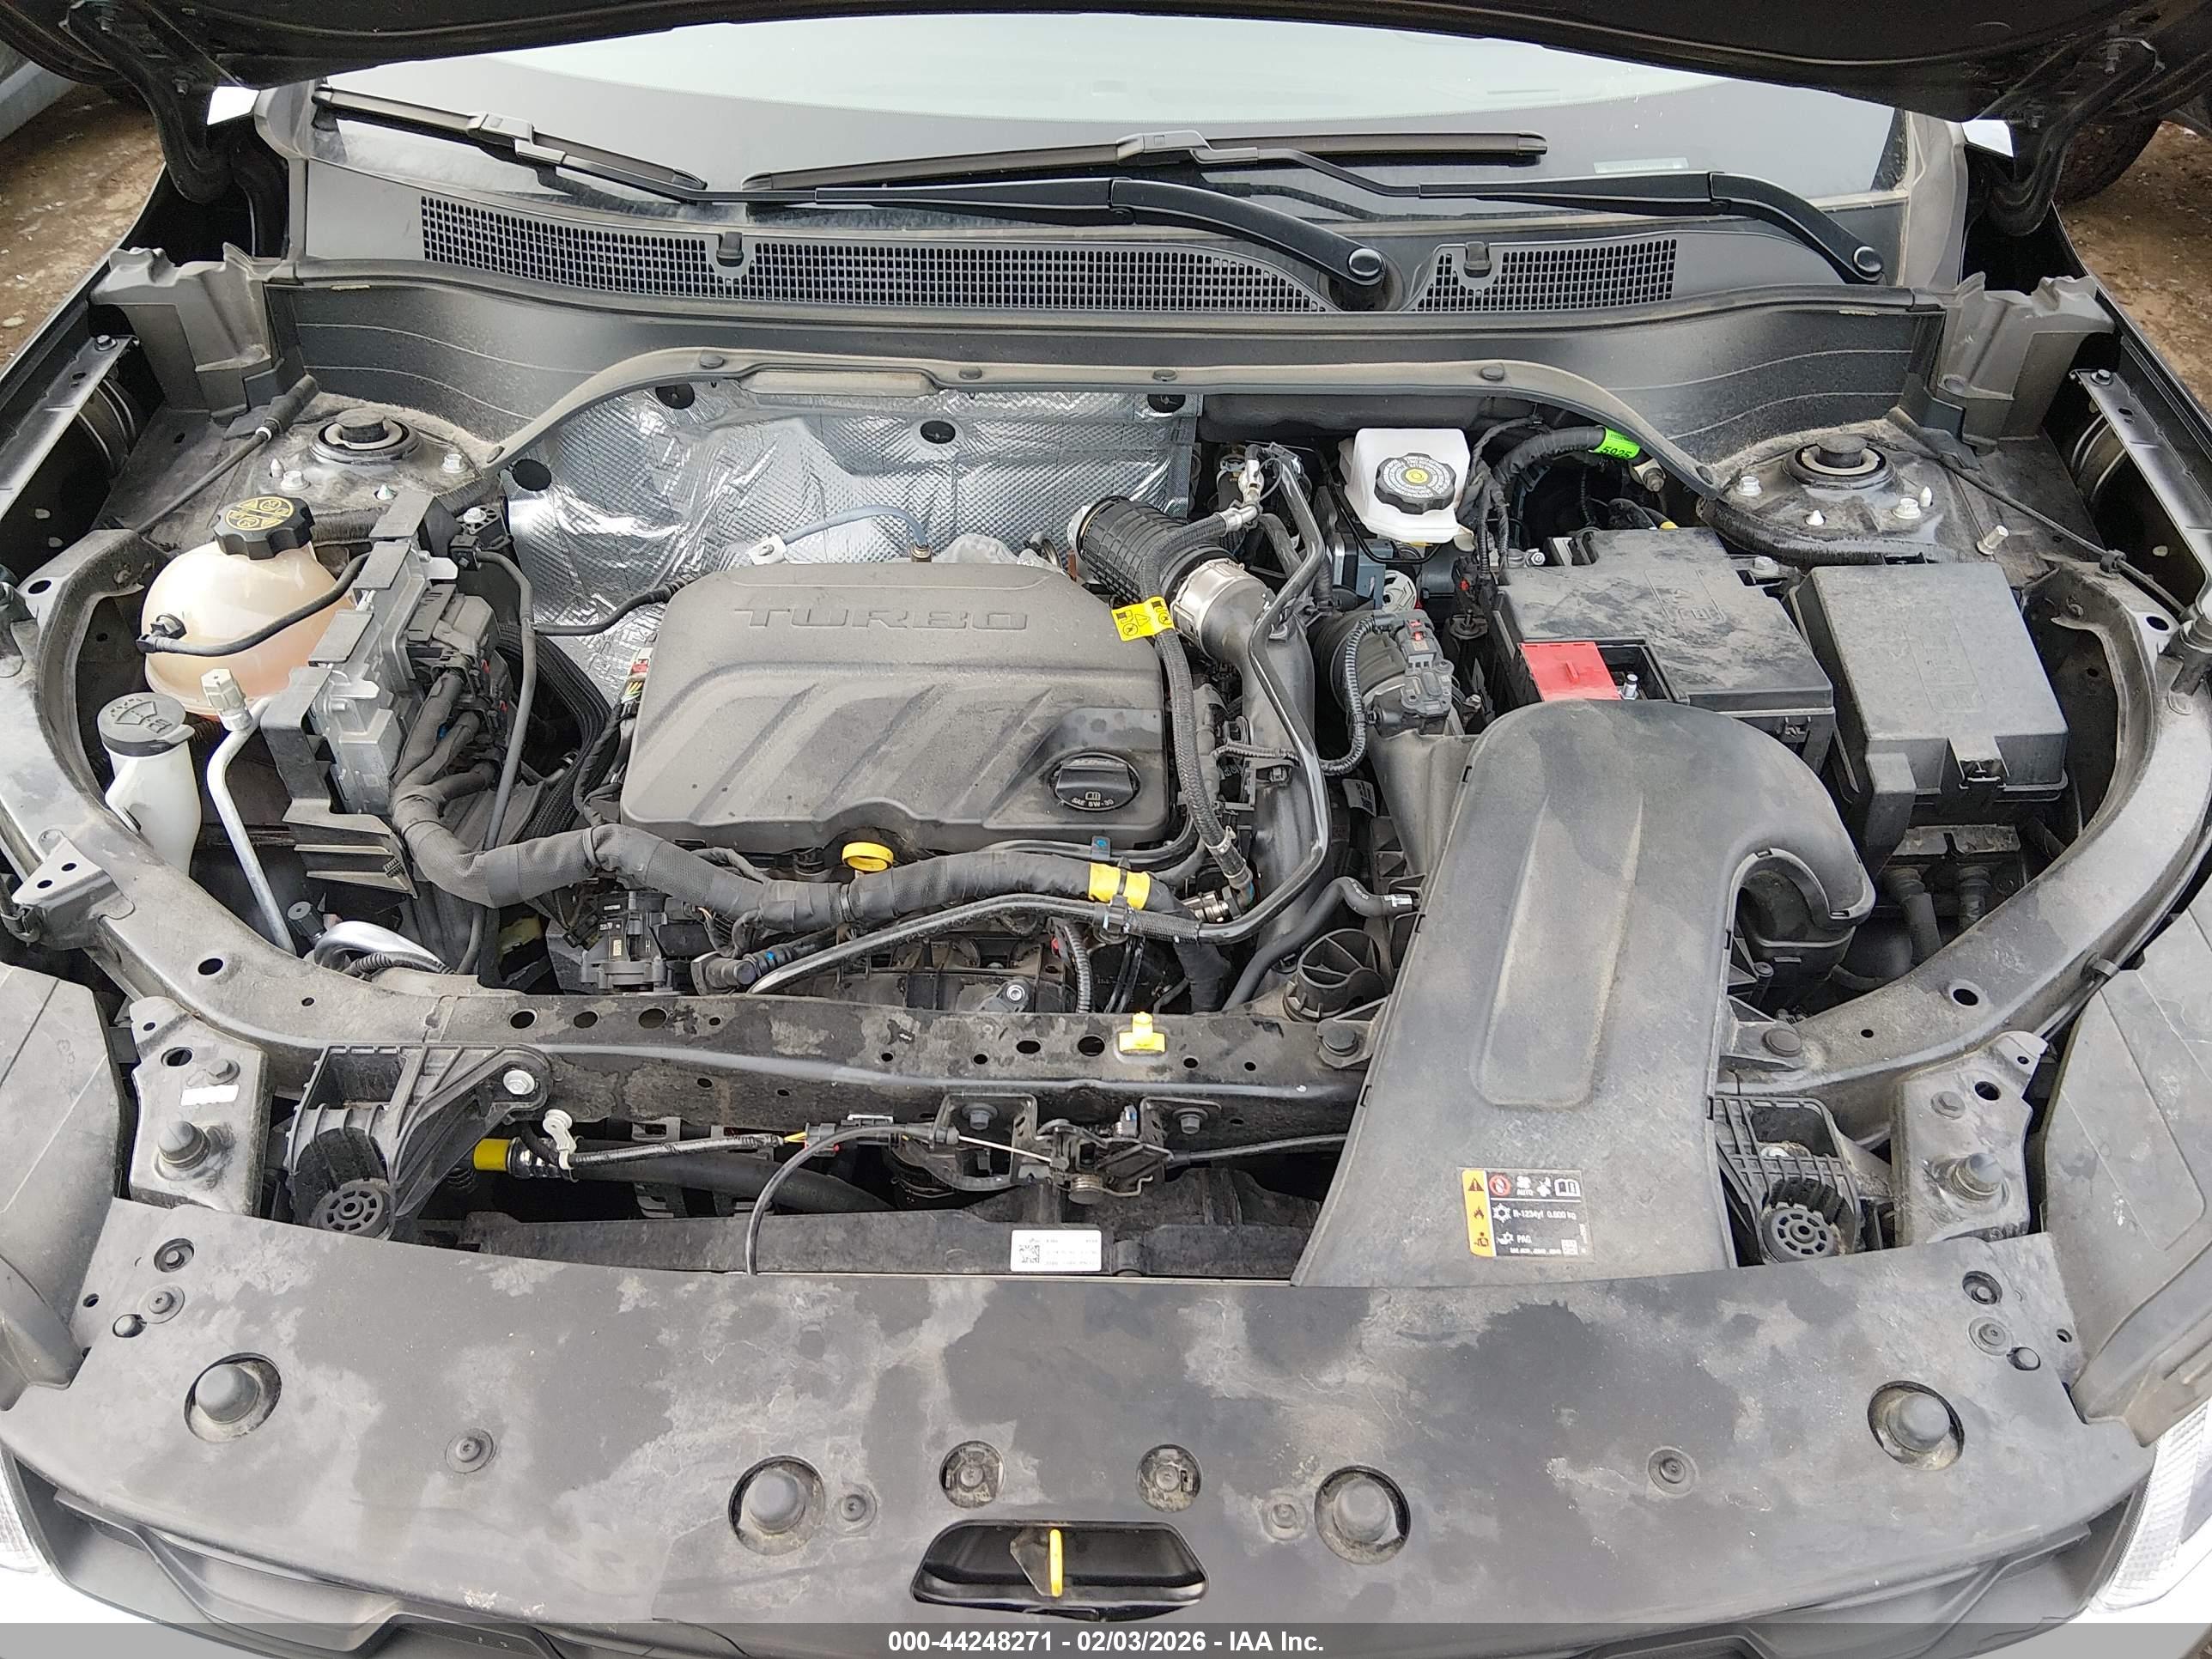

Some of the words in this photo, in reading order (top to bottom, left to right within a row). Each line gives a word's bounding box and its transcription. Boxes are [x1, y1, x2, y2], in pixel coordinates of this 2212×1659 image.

[733, 608, 1028, 631] TURBO
[1071, 797, 1086, 806] SAE
[1087, 798, 1115, 807] 5W-30
